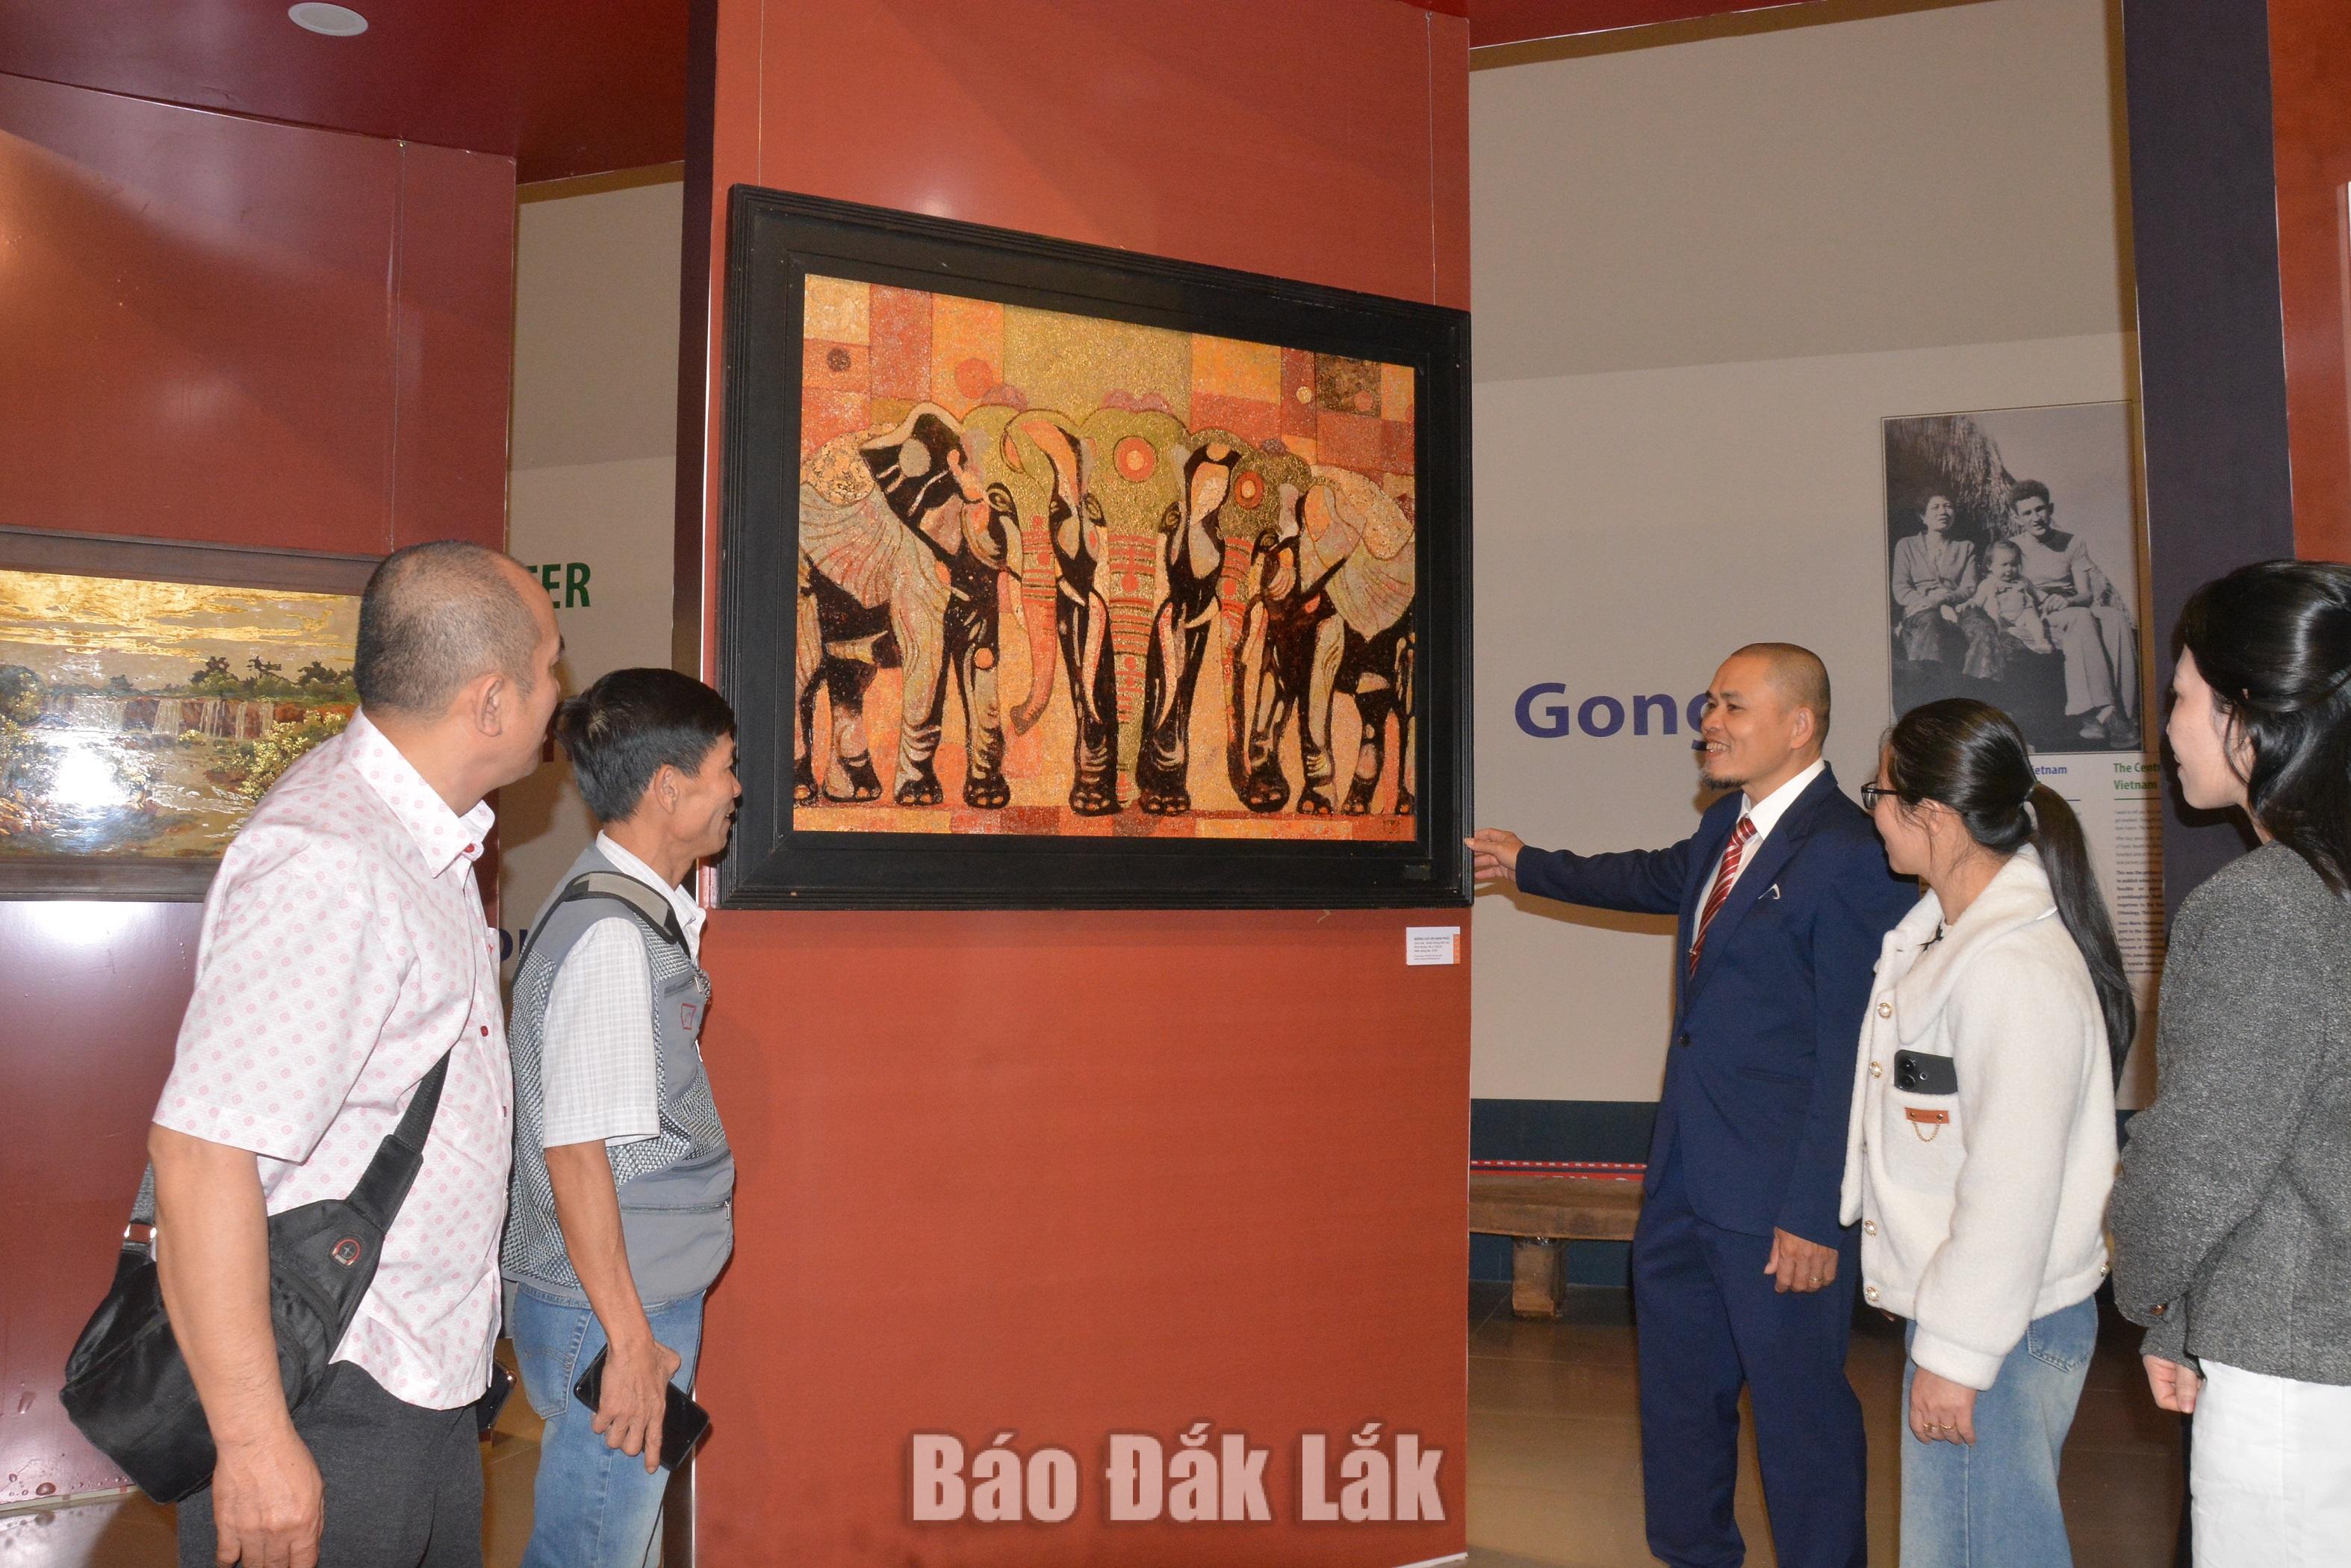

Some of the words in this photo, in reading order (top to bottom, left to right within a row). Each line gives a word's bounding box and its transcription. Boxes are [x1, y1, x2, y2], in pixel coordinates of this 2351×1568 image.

[2031, 765, 2067, 775] etnam
[2114, 762, 2131, 773] The
[2114, 780, 2158, 790] Vietnam
